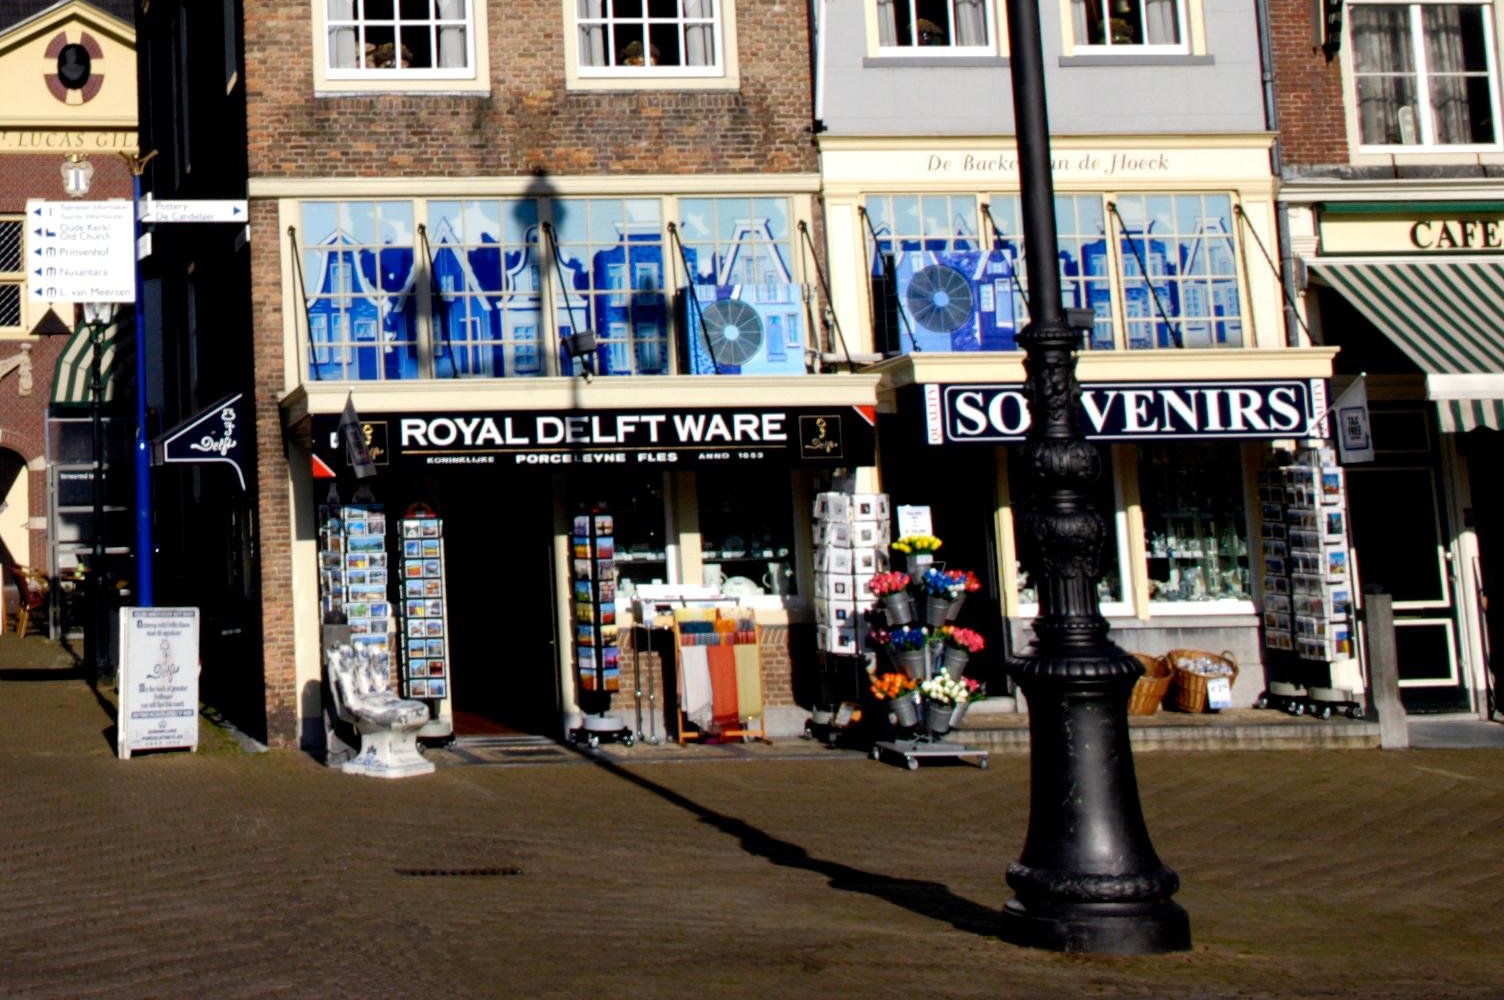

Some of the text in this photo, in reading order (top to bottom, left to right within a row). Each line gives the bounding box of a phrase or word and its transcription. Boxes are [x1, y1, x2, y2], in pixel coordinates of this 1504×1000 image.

[18, 131, 85, 147] LUCAS
[95, 131, 139, 147] GIL
[928, 153, 1169, 175] De Backe an de Hoeck
[156, 201, 188, 210] Pottery
[156, 212, 168, 220] De
[60, 223, 84, 232] Oude
[60, 231, 111, 240] Old Church
[1409, 220, 1503, 249] CAFE
[60, 247, 110, 256] Prinsenhof
[60, 268, 108, 276] Nusantara
[71, 289, 87, 297] van
[91, 287, 131, 296] Meerten
[928, 389, 940, 442] QUALITY
[955, 387, 1300, 436] SOVENIRS
[400, 417, 529, 446] ROYAL
[536, 414, 666, 444] DELFT
[672, 413, 788, 442] WARE
[515, 453, 626, 464] PORCELEYNE
[637, 452, 678, 462] FLES
[698, 452, 730, 460] ANNO
